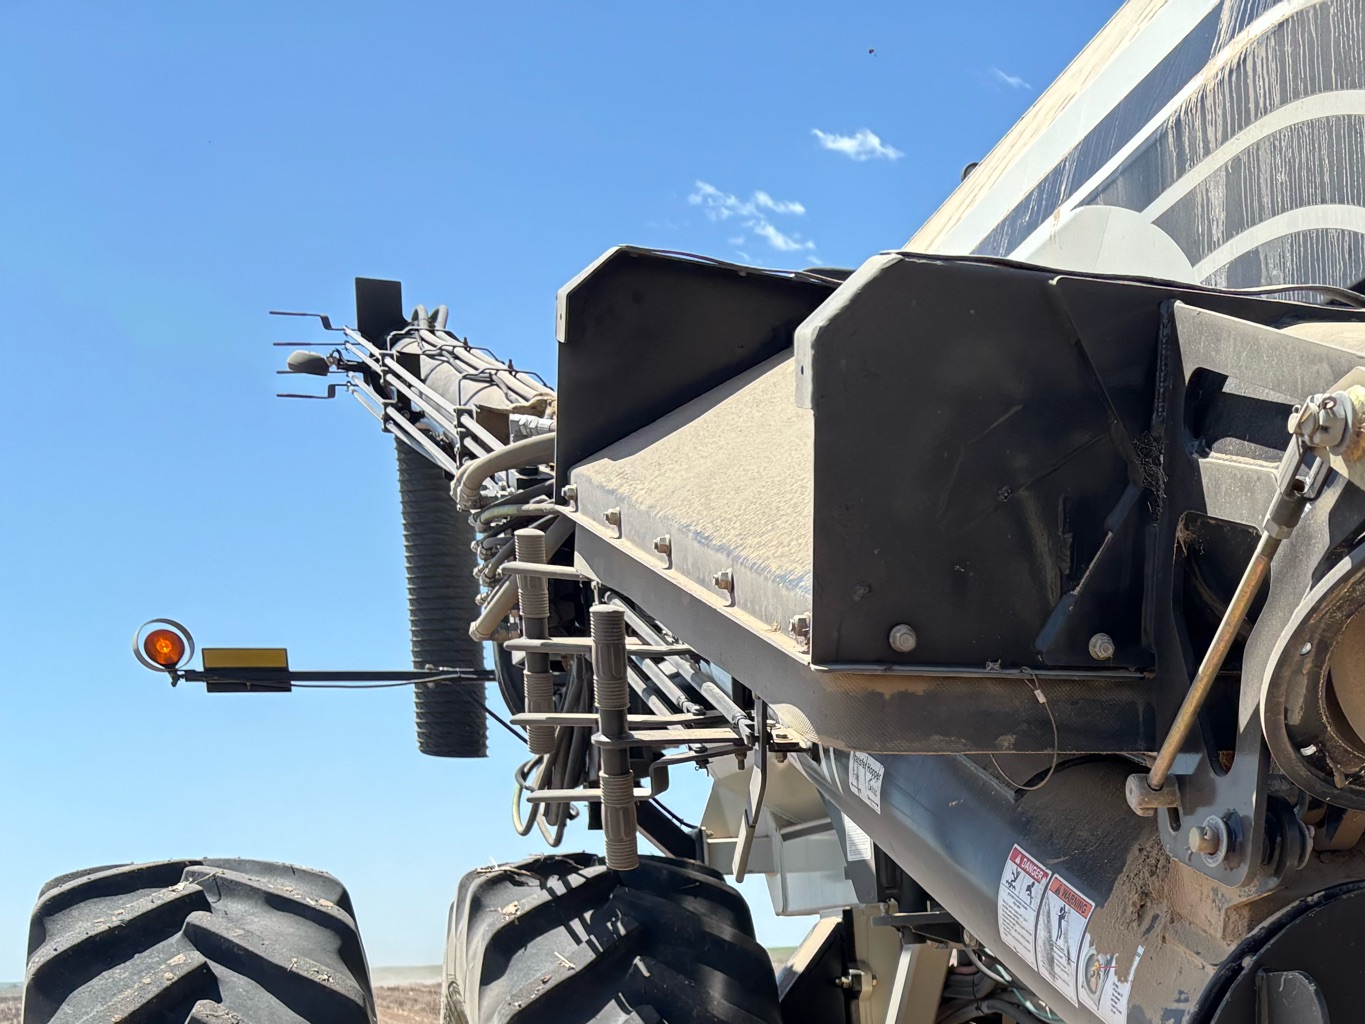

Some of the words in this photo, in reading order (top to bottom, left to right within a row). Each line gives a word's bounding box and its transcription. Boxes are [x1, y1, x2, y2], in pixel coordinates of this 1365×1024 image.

[867, 762, 882, 783] Hopper
[1022, 857, 1044, 881] DANGER
[1061, 887, 1088, 914] WARNING
